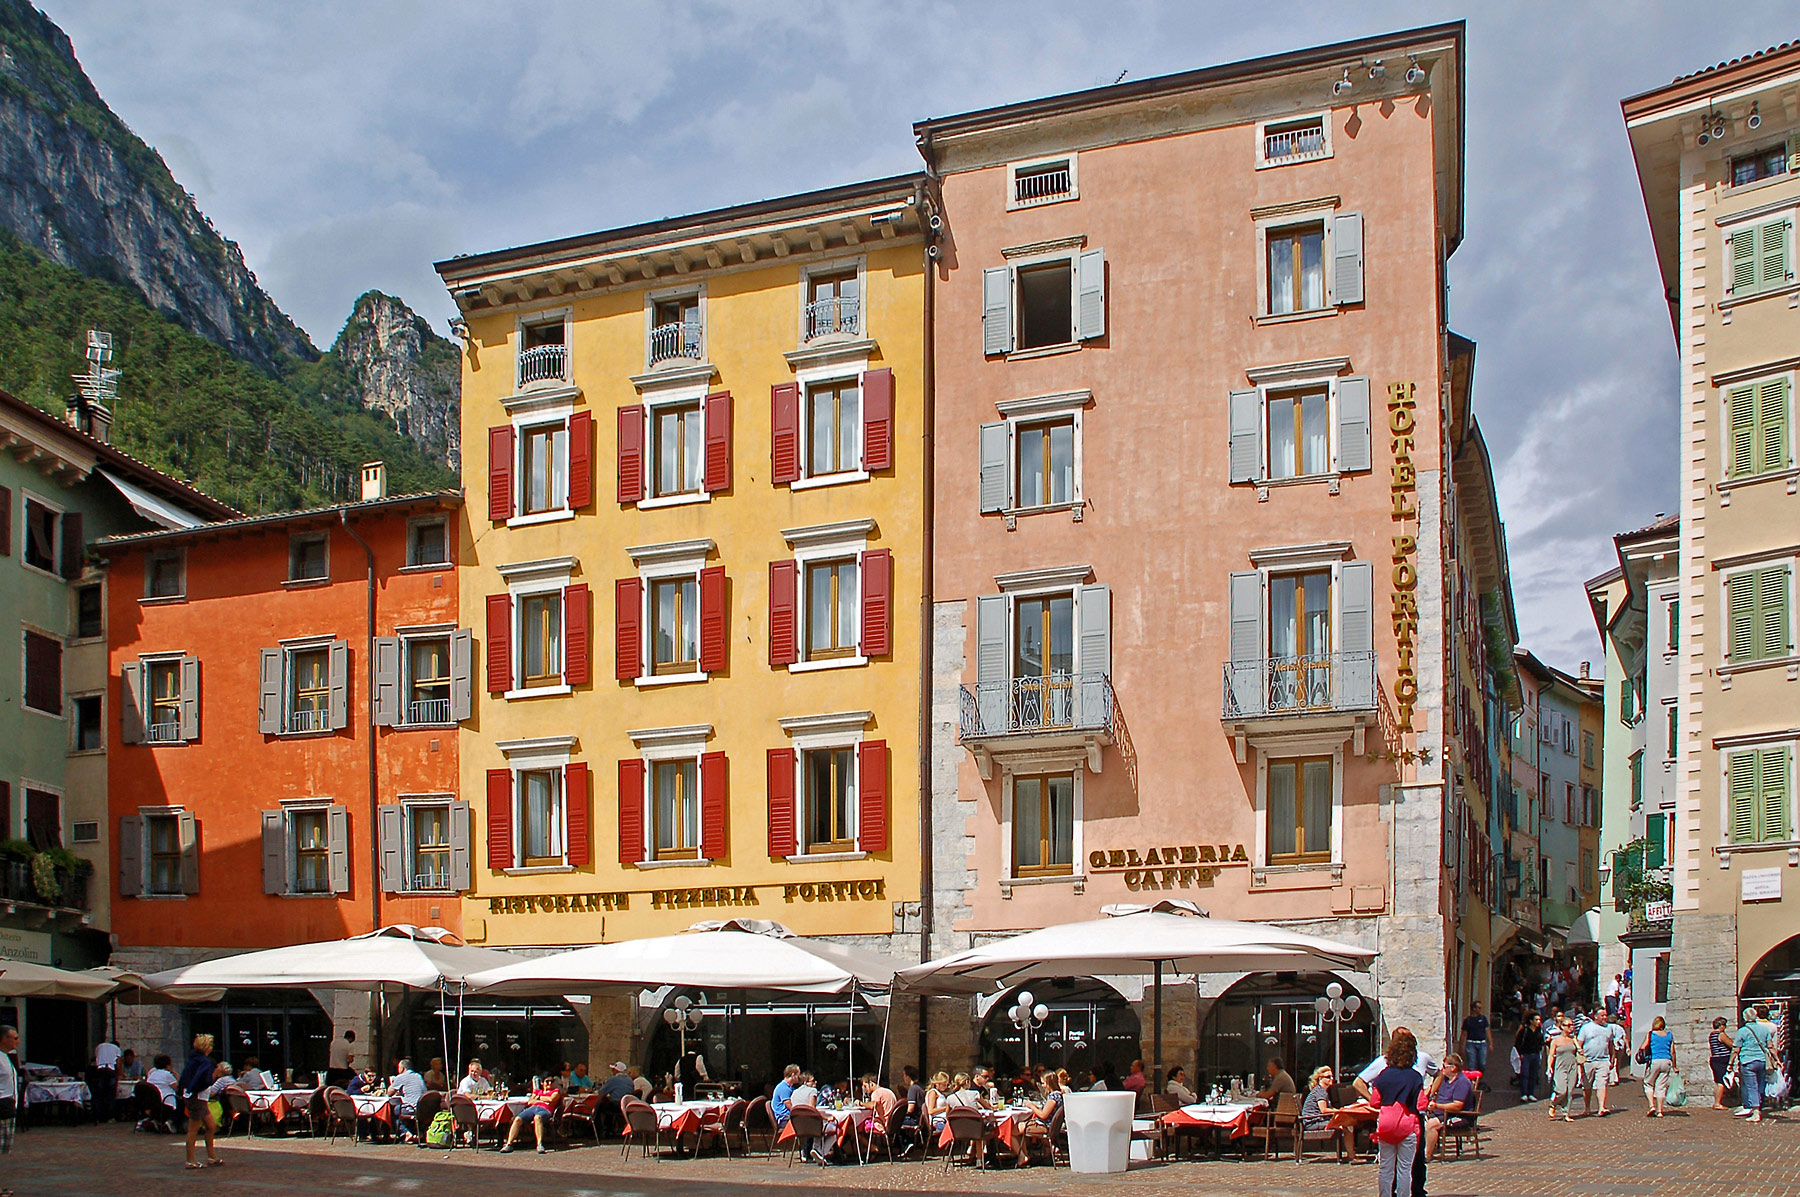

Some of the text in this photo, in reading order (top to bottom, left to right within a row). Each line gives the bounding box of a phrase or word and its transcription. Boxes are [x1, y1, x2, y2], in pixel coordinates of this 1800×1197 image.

[1387, 381, 1418, 732] HOTEL PORTICI
[1089, 844, 1249, 868] GELATERIA
[488, 880, 886, 914] RISTORANTE PIZZERIA PORTICI
